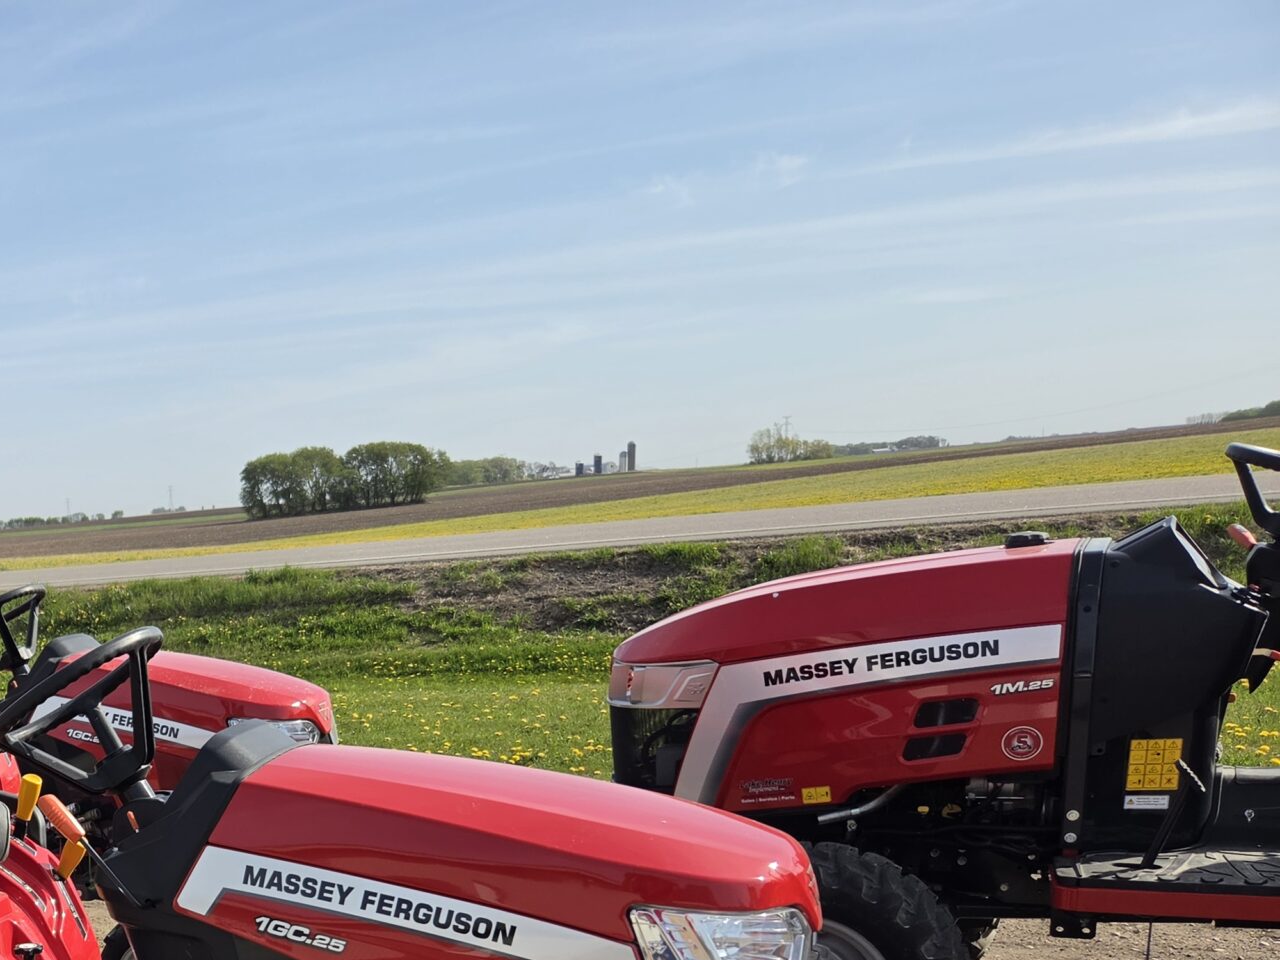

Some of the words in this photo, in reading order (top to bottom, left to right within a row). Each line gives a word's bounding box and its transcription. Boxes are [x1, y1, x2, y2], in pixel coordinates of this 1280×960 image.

[763, 657, 859, 687] MASSEY
[866, 639, 1000, 672] FERGUSON
[990, 679, 1055, 695] 1M.25
[111, 713, 180, 739] FERSON
[242, 865, 354, 906] MASSEY
[360, 890, 517, 947] FERGUSON
[255, 916, 347, 952] 1GC.25
